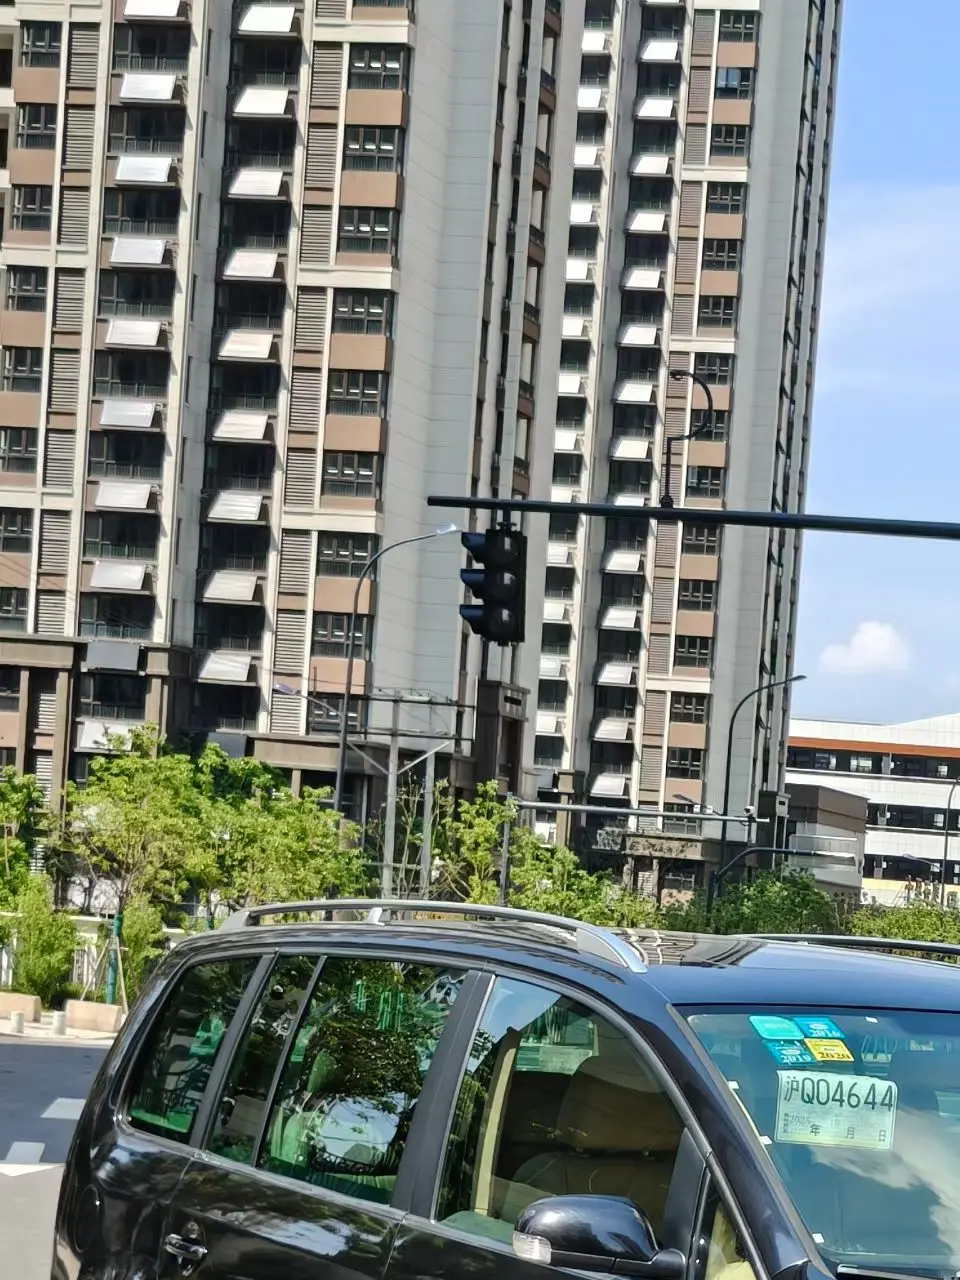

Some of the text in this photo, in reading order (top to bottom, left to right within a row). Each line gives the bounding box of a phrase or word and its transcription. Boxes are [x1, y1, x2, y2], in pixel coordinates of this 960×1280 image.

[780, 1054, 812, 1064] 2019
[818, 1051, 851, 1060] 2020
[784, 1075, 893, 1111] 沪Q04644
